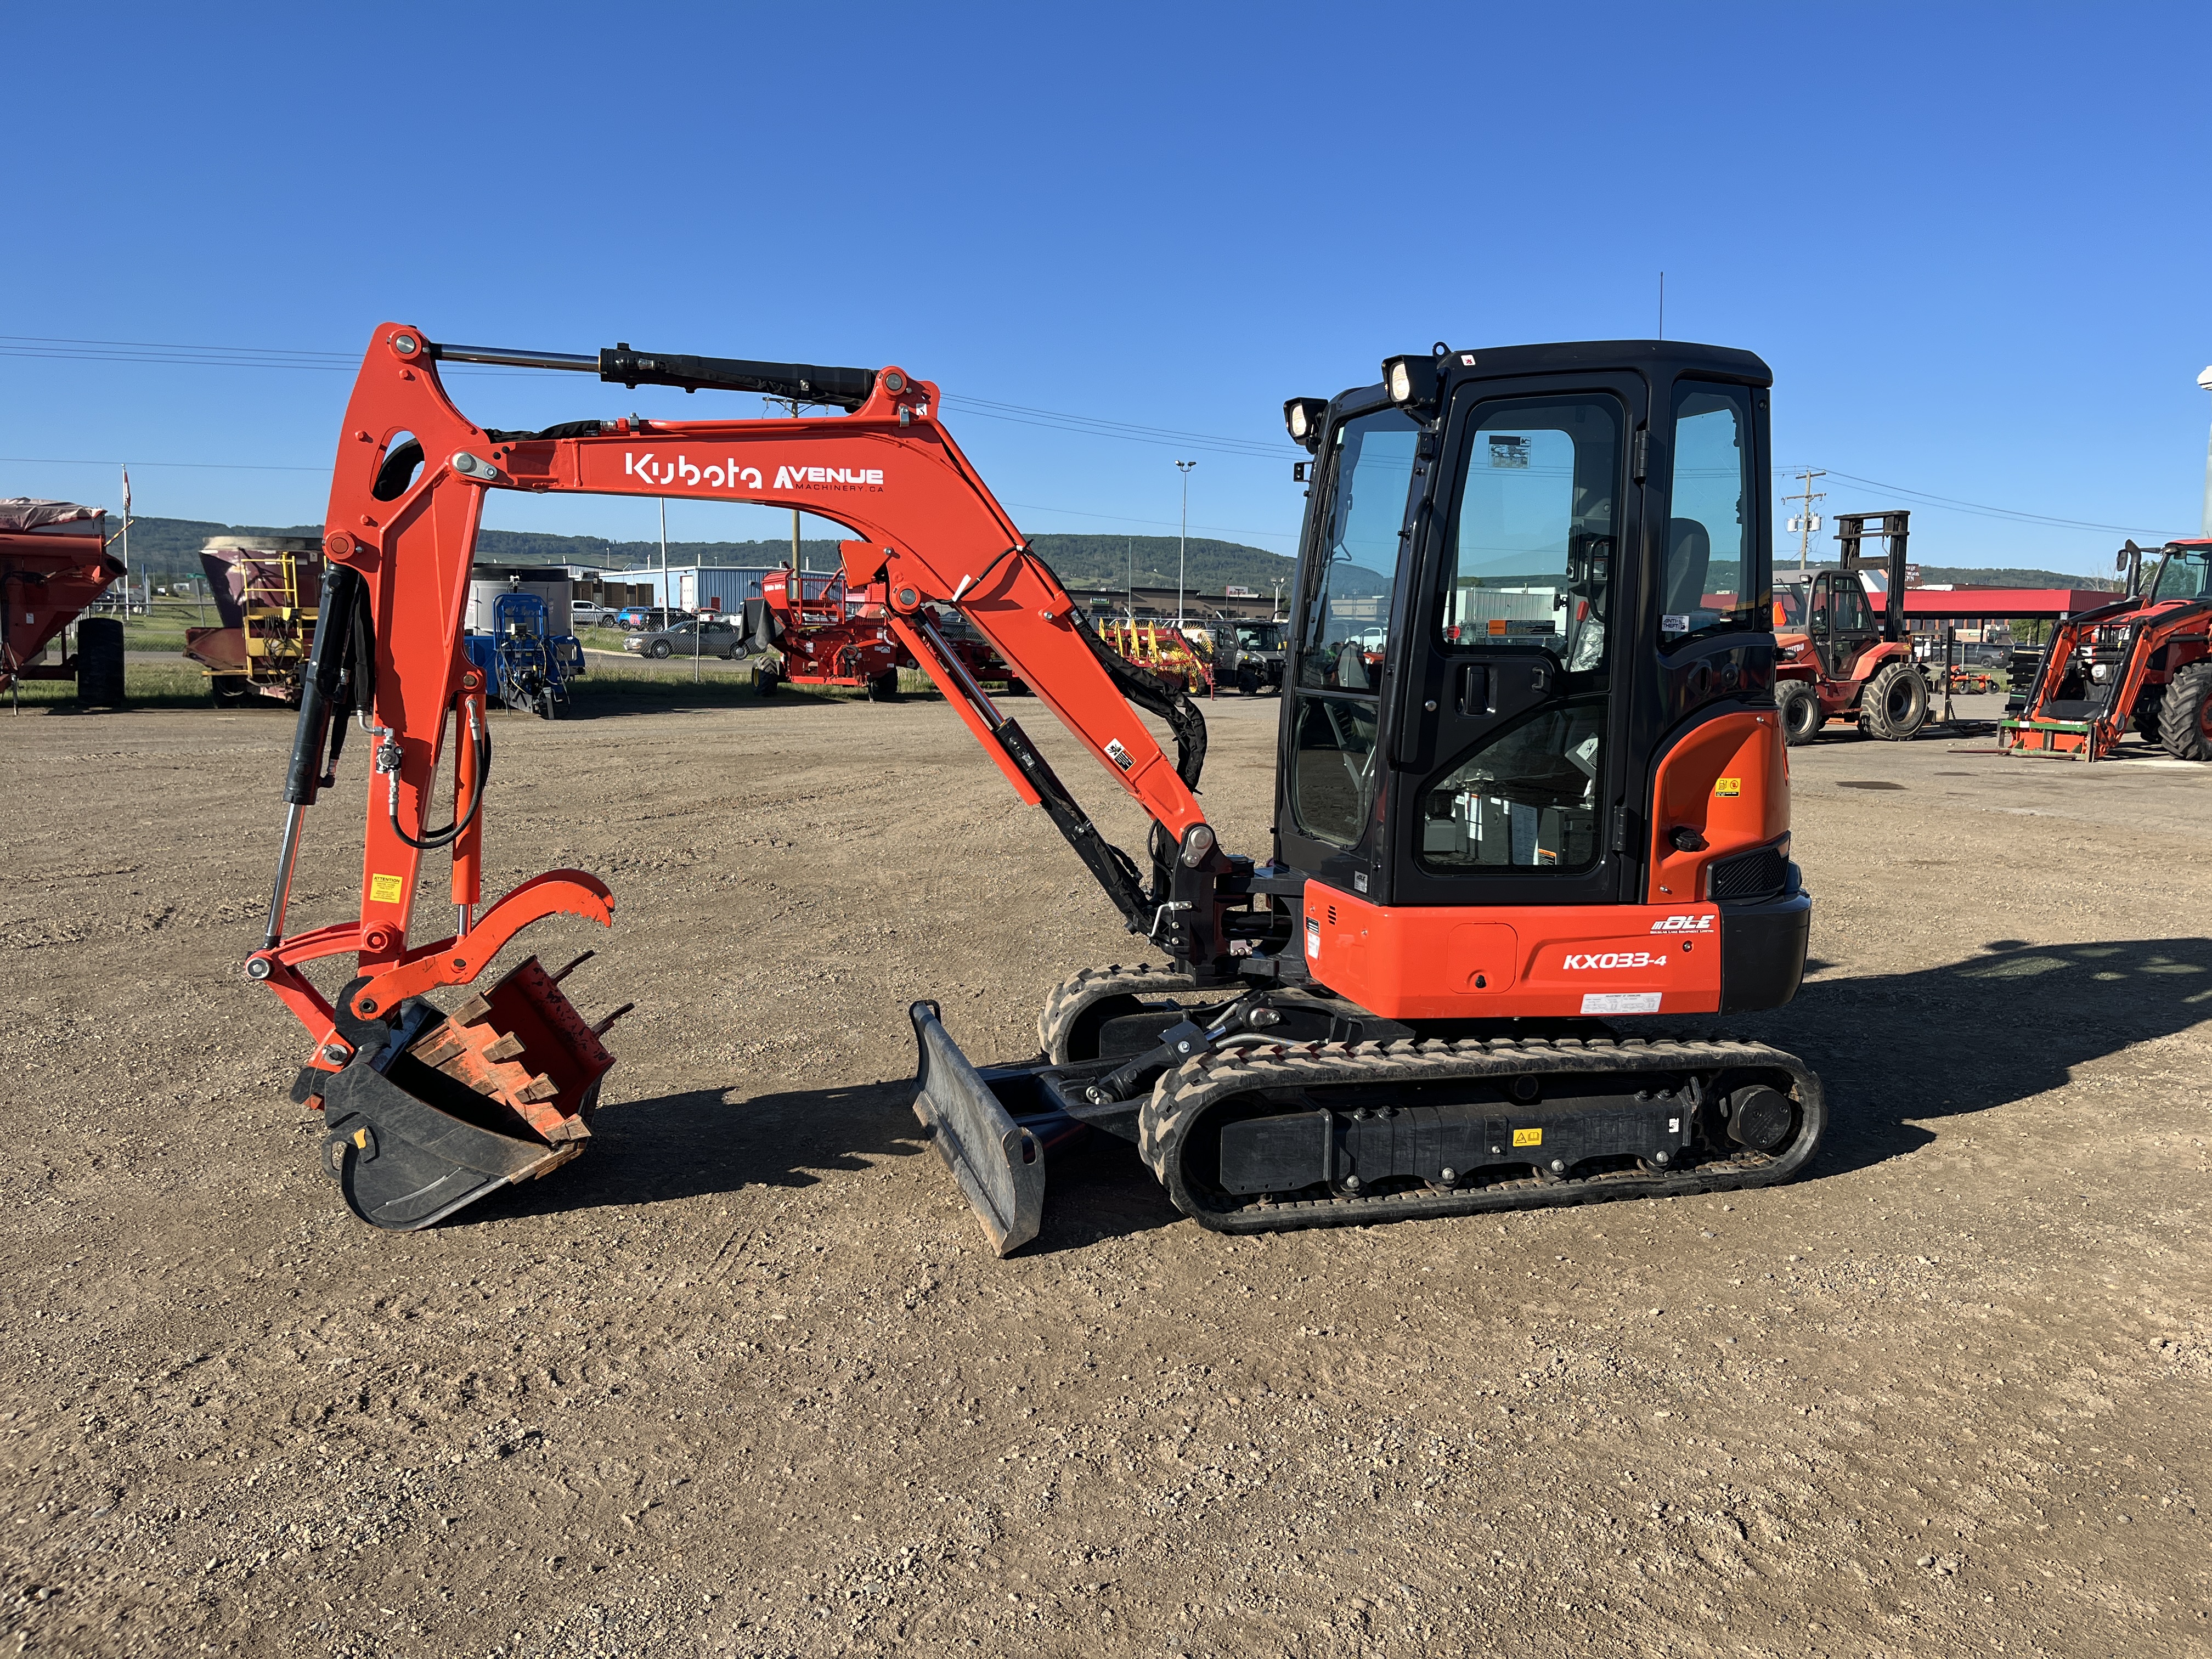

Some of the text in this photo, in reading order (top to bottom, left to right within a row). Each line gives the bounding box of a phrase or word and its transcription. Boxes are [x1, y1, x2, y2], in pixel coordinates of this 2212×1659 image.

[625, 452, 884, 489] Kubota AVENUE
[795, 483, 884, 493] MACHINERY.CA
[1562, 952, 1667, 969] KX033-4
